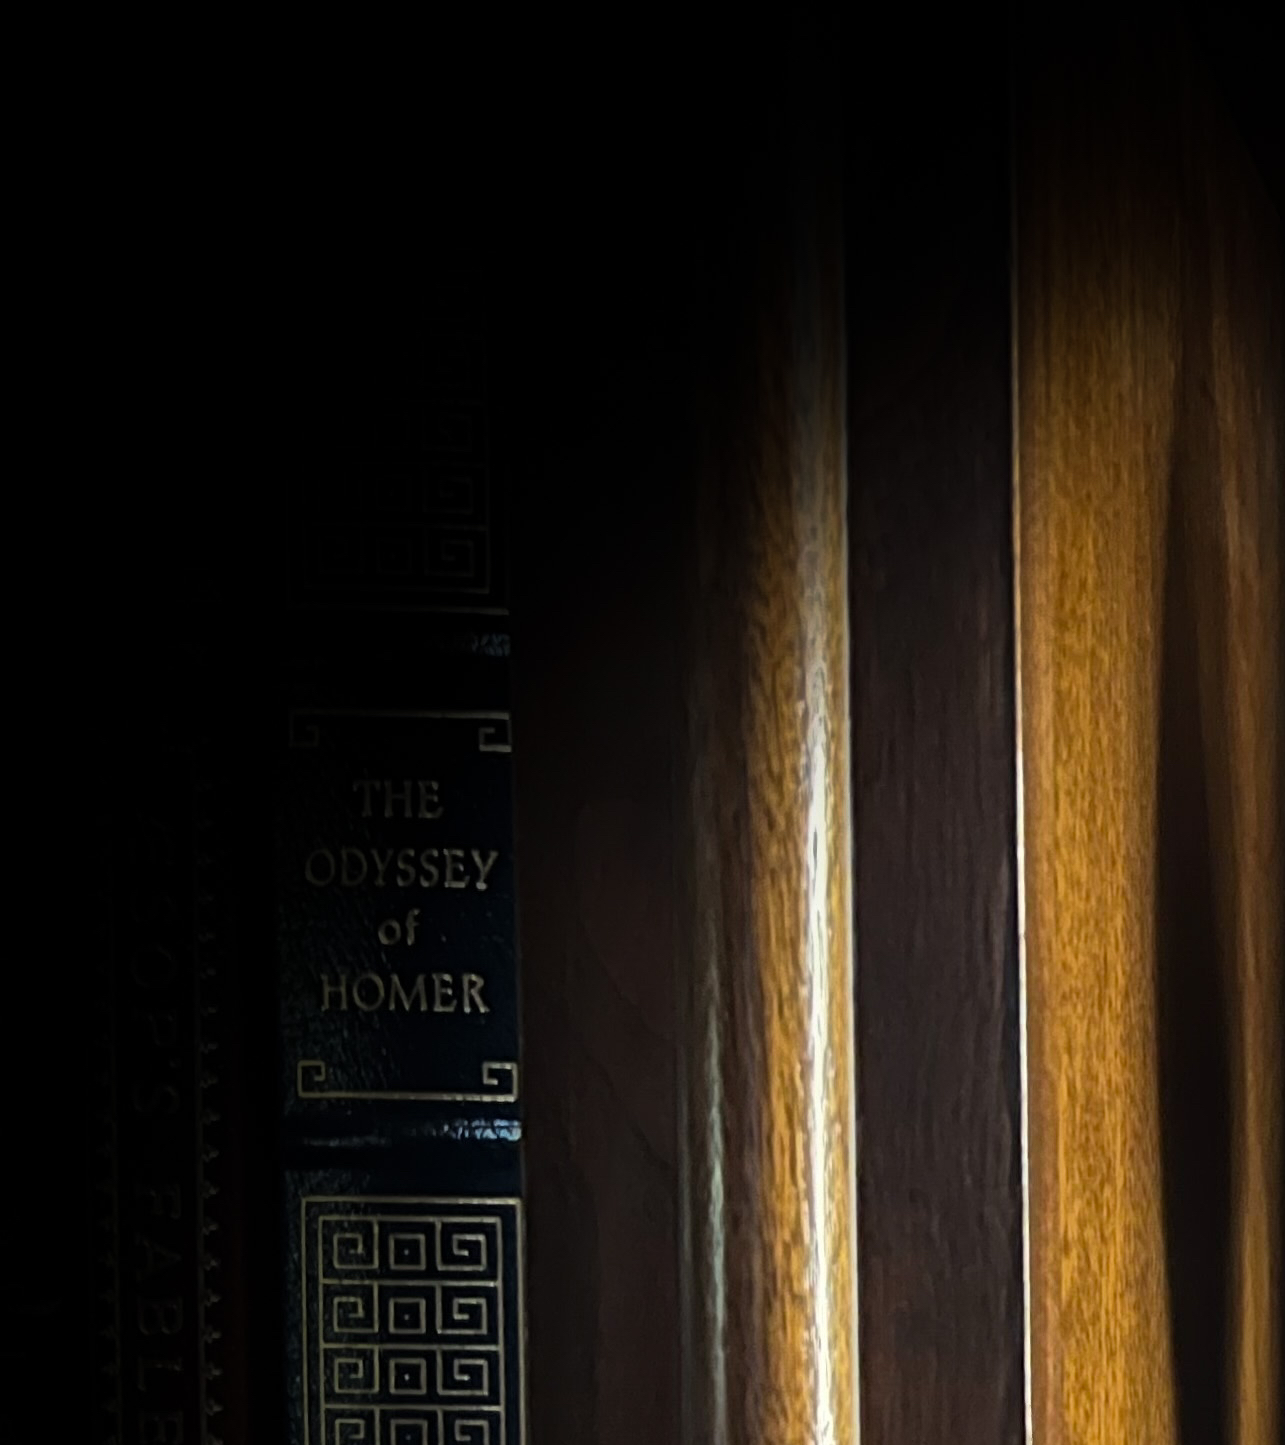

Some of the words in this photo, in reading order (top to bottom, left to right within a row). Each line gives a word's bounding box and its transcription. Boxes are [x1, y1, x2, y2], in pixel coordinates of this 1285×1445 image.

[352, 777, 445, 820] THE
[304, 847, 500, 892] ODYSSEY
[377, 905, 422, 947] of
[319, 970, 492, 1015] HOMER
